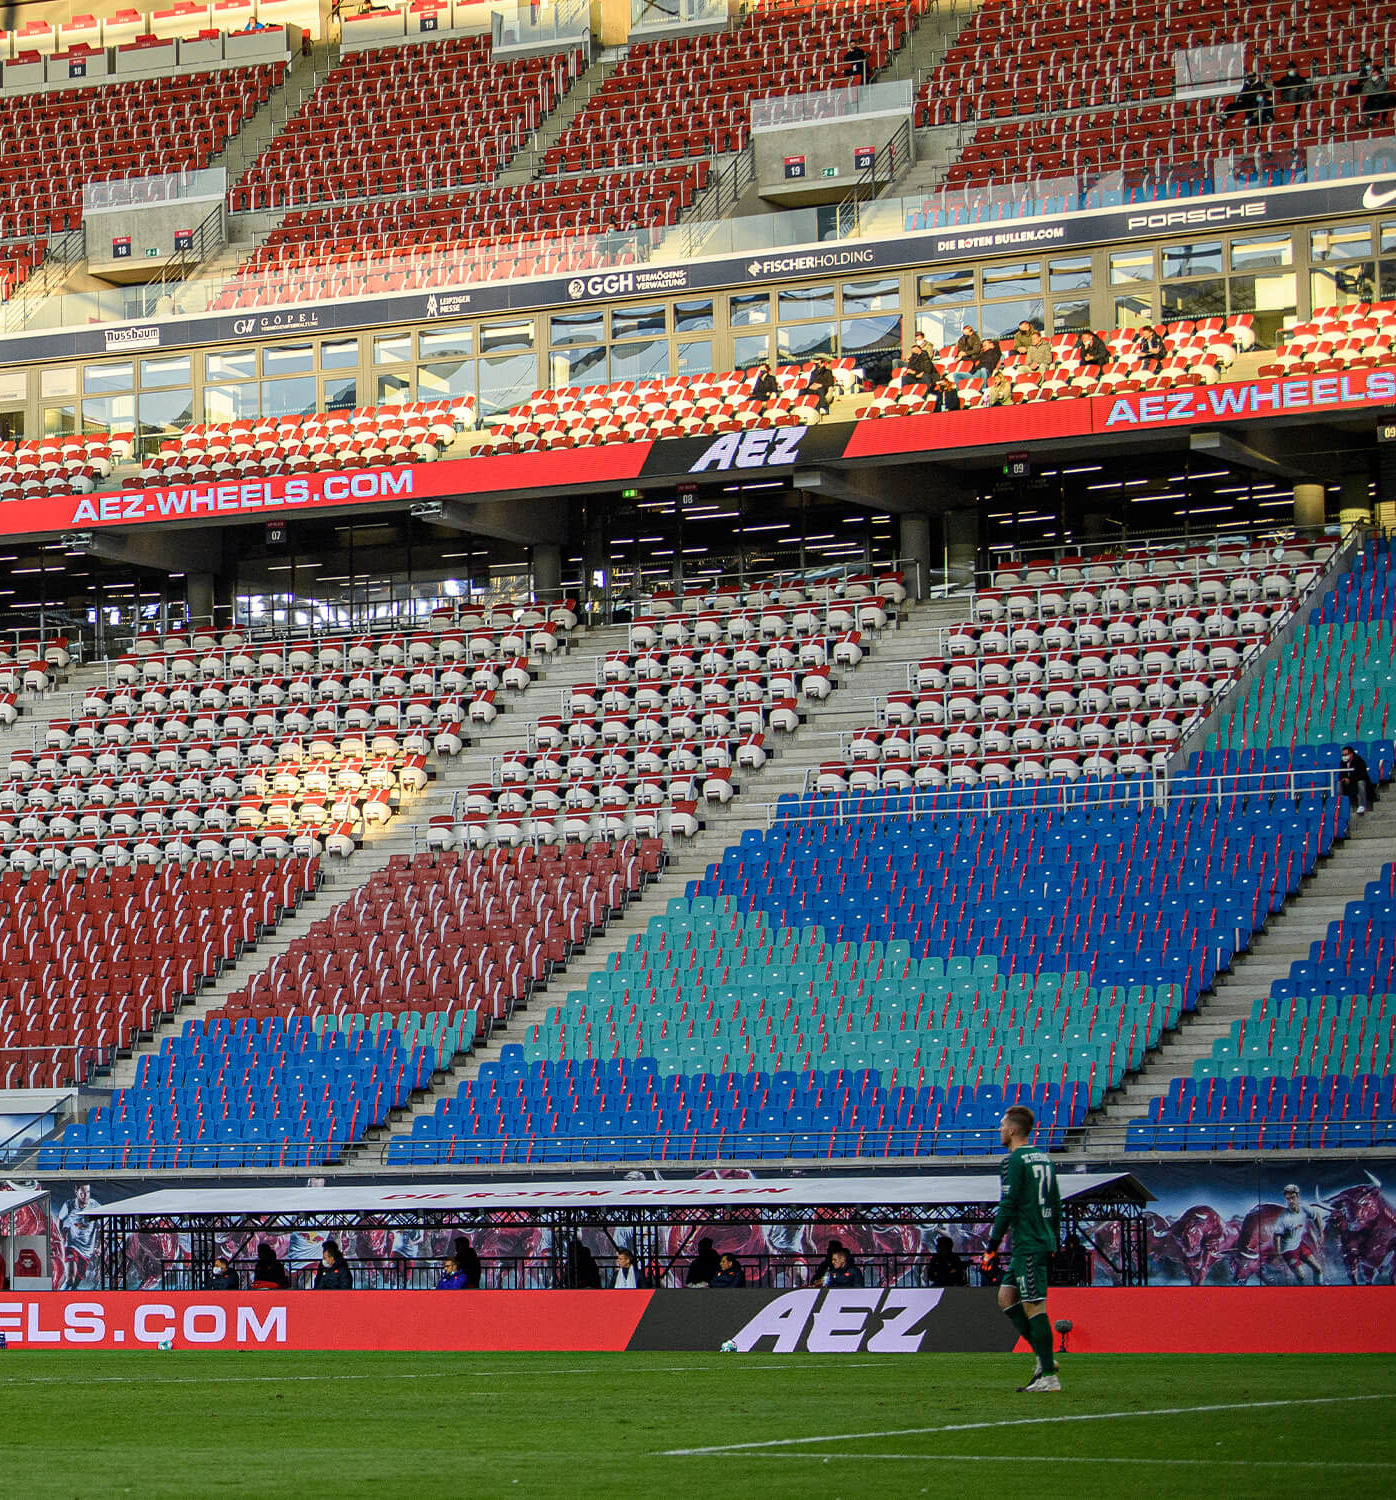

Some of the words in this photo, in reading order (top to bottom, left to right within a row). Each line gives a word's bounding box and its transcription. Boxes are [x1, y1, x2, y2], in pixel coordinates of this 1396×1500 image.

[425, 19, 434, 29] 19
[859, 156, 870, 167] 20
[790, 165, 800, 176] 19
[1128, 202, 1266, 231] PORSCHE
[937, 241, 956, 252] DIE
[994, 227, 1064, 245] BULLEN.COM
[117, 245, 127, 255] 18
[763, 249, 874, 274] FISCHERHOLDING
[636, 269, 687, 283] VERMÖGENS-
[587, 273, 634, 295] GGH
[636, 278, 686, 291] VERWALTUNG
[1106, 371, 1396, 426] AEZ-WHEELS
[687, 425, 809, 473] AEZ
[1013, 463, 1024, 474] 09
[71, 470, 413, 524] AEZ-WHEELS.COM
[271, 530, 281, 541] 07
[619, 1188, 794, 1197] BULLEN
[728, 1288, 944, 1352] AEZ
